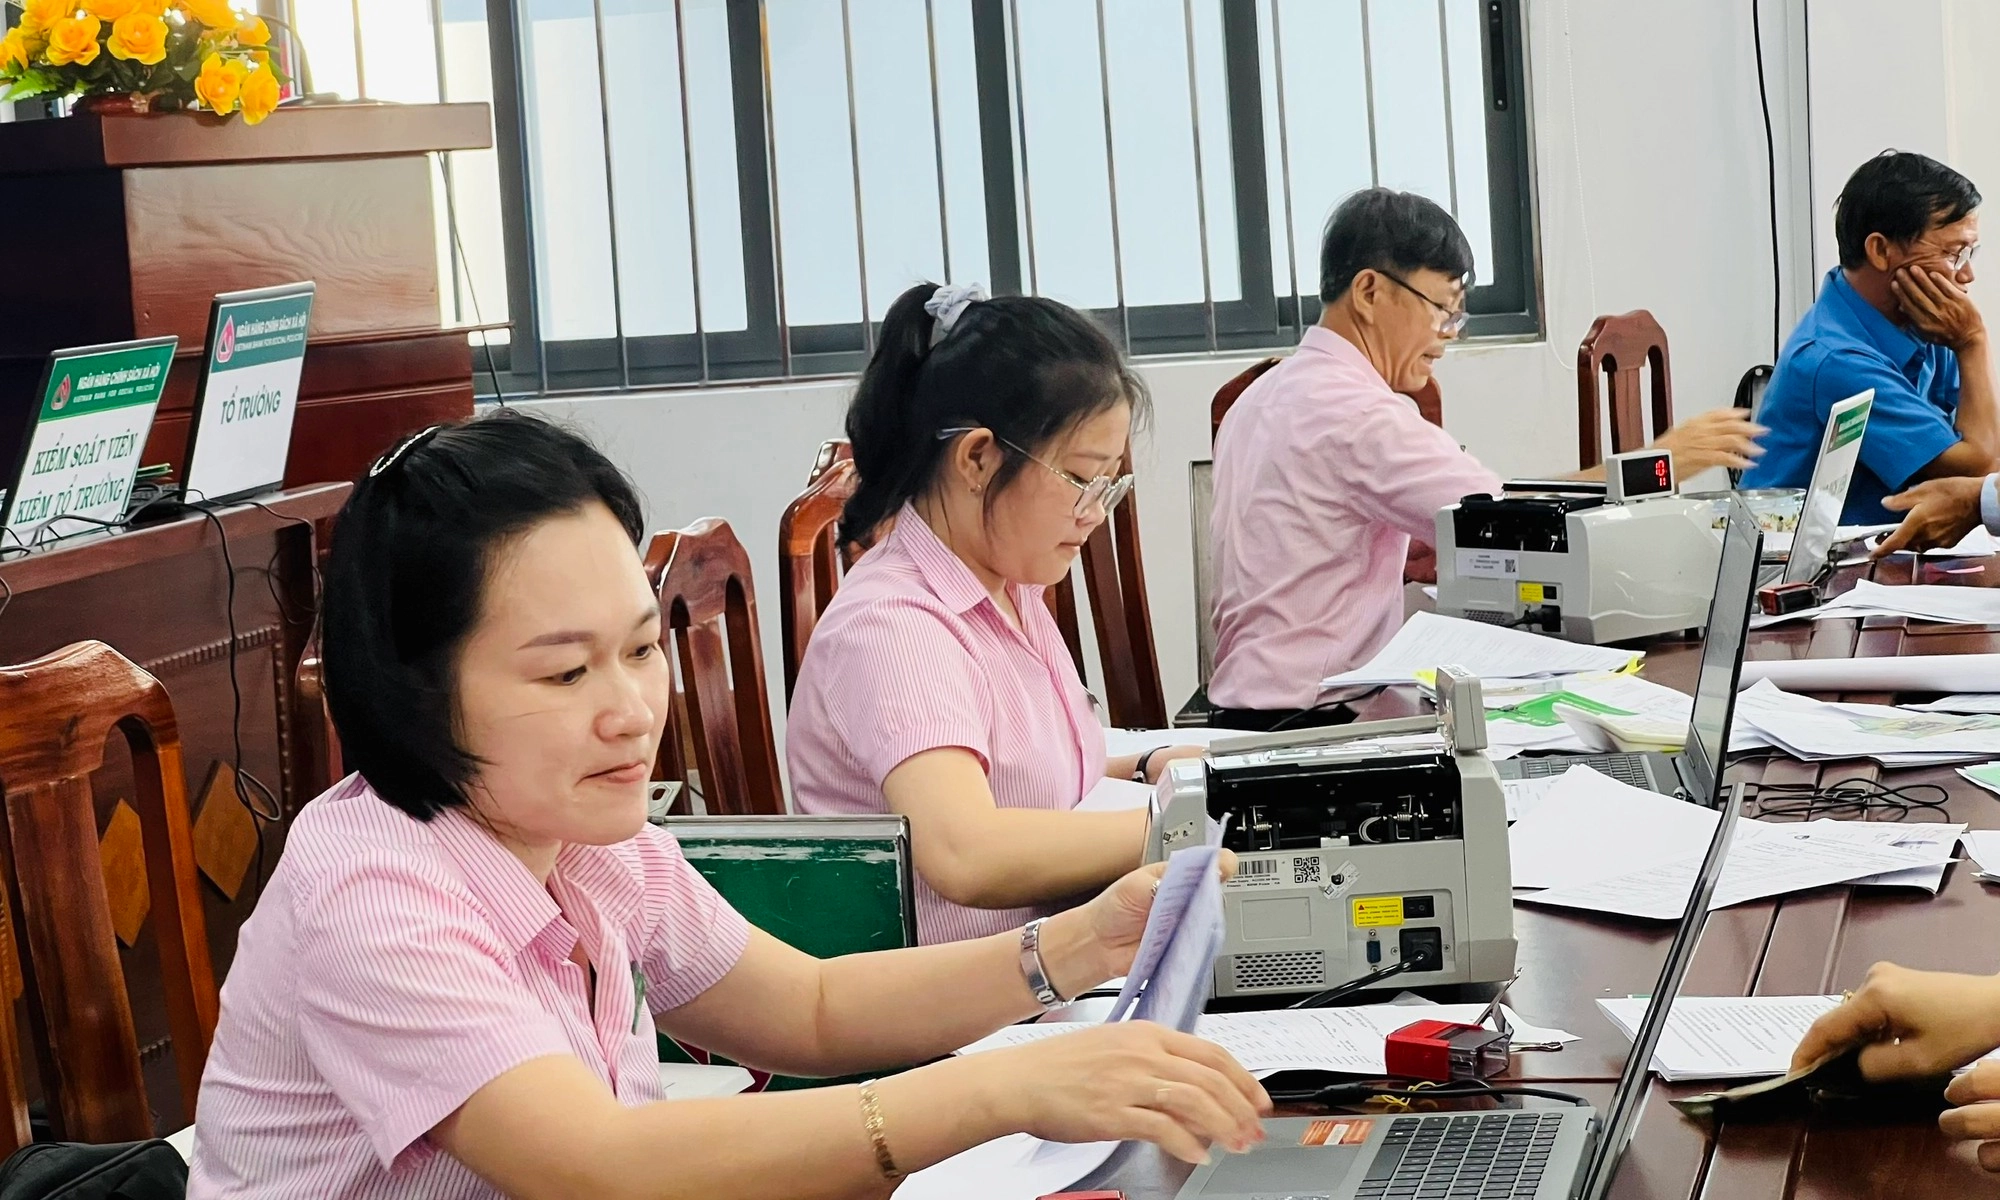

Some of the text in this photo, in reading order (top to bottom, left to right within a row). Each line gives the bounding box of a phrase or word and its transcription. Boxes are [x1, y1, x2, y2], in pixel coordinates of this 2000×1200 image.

[220, 384, 281, 424] TỔ TRƯỞNG
[32, 428, 138, 475] KIỂM SOÁT VIÊN
[14, 472, 125, 524] KIÊM TỔ TRƯỞNG
